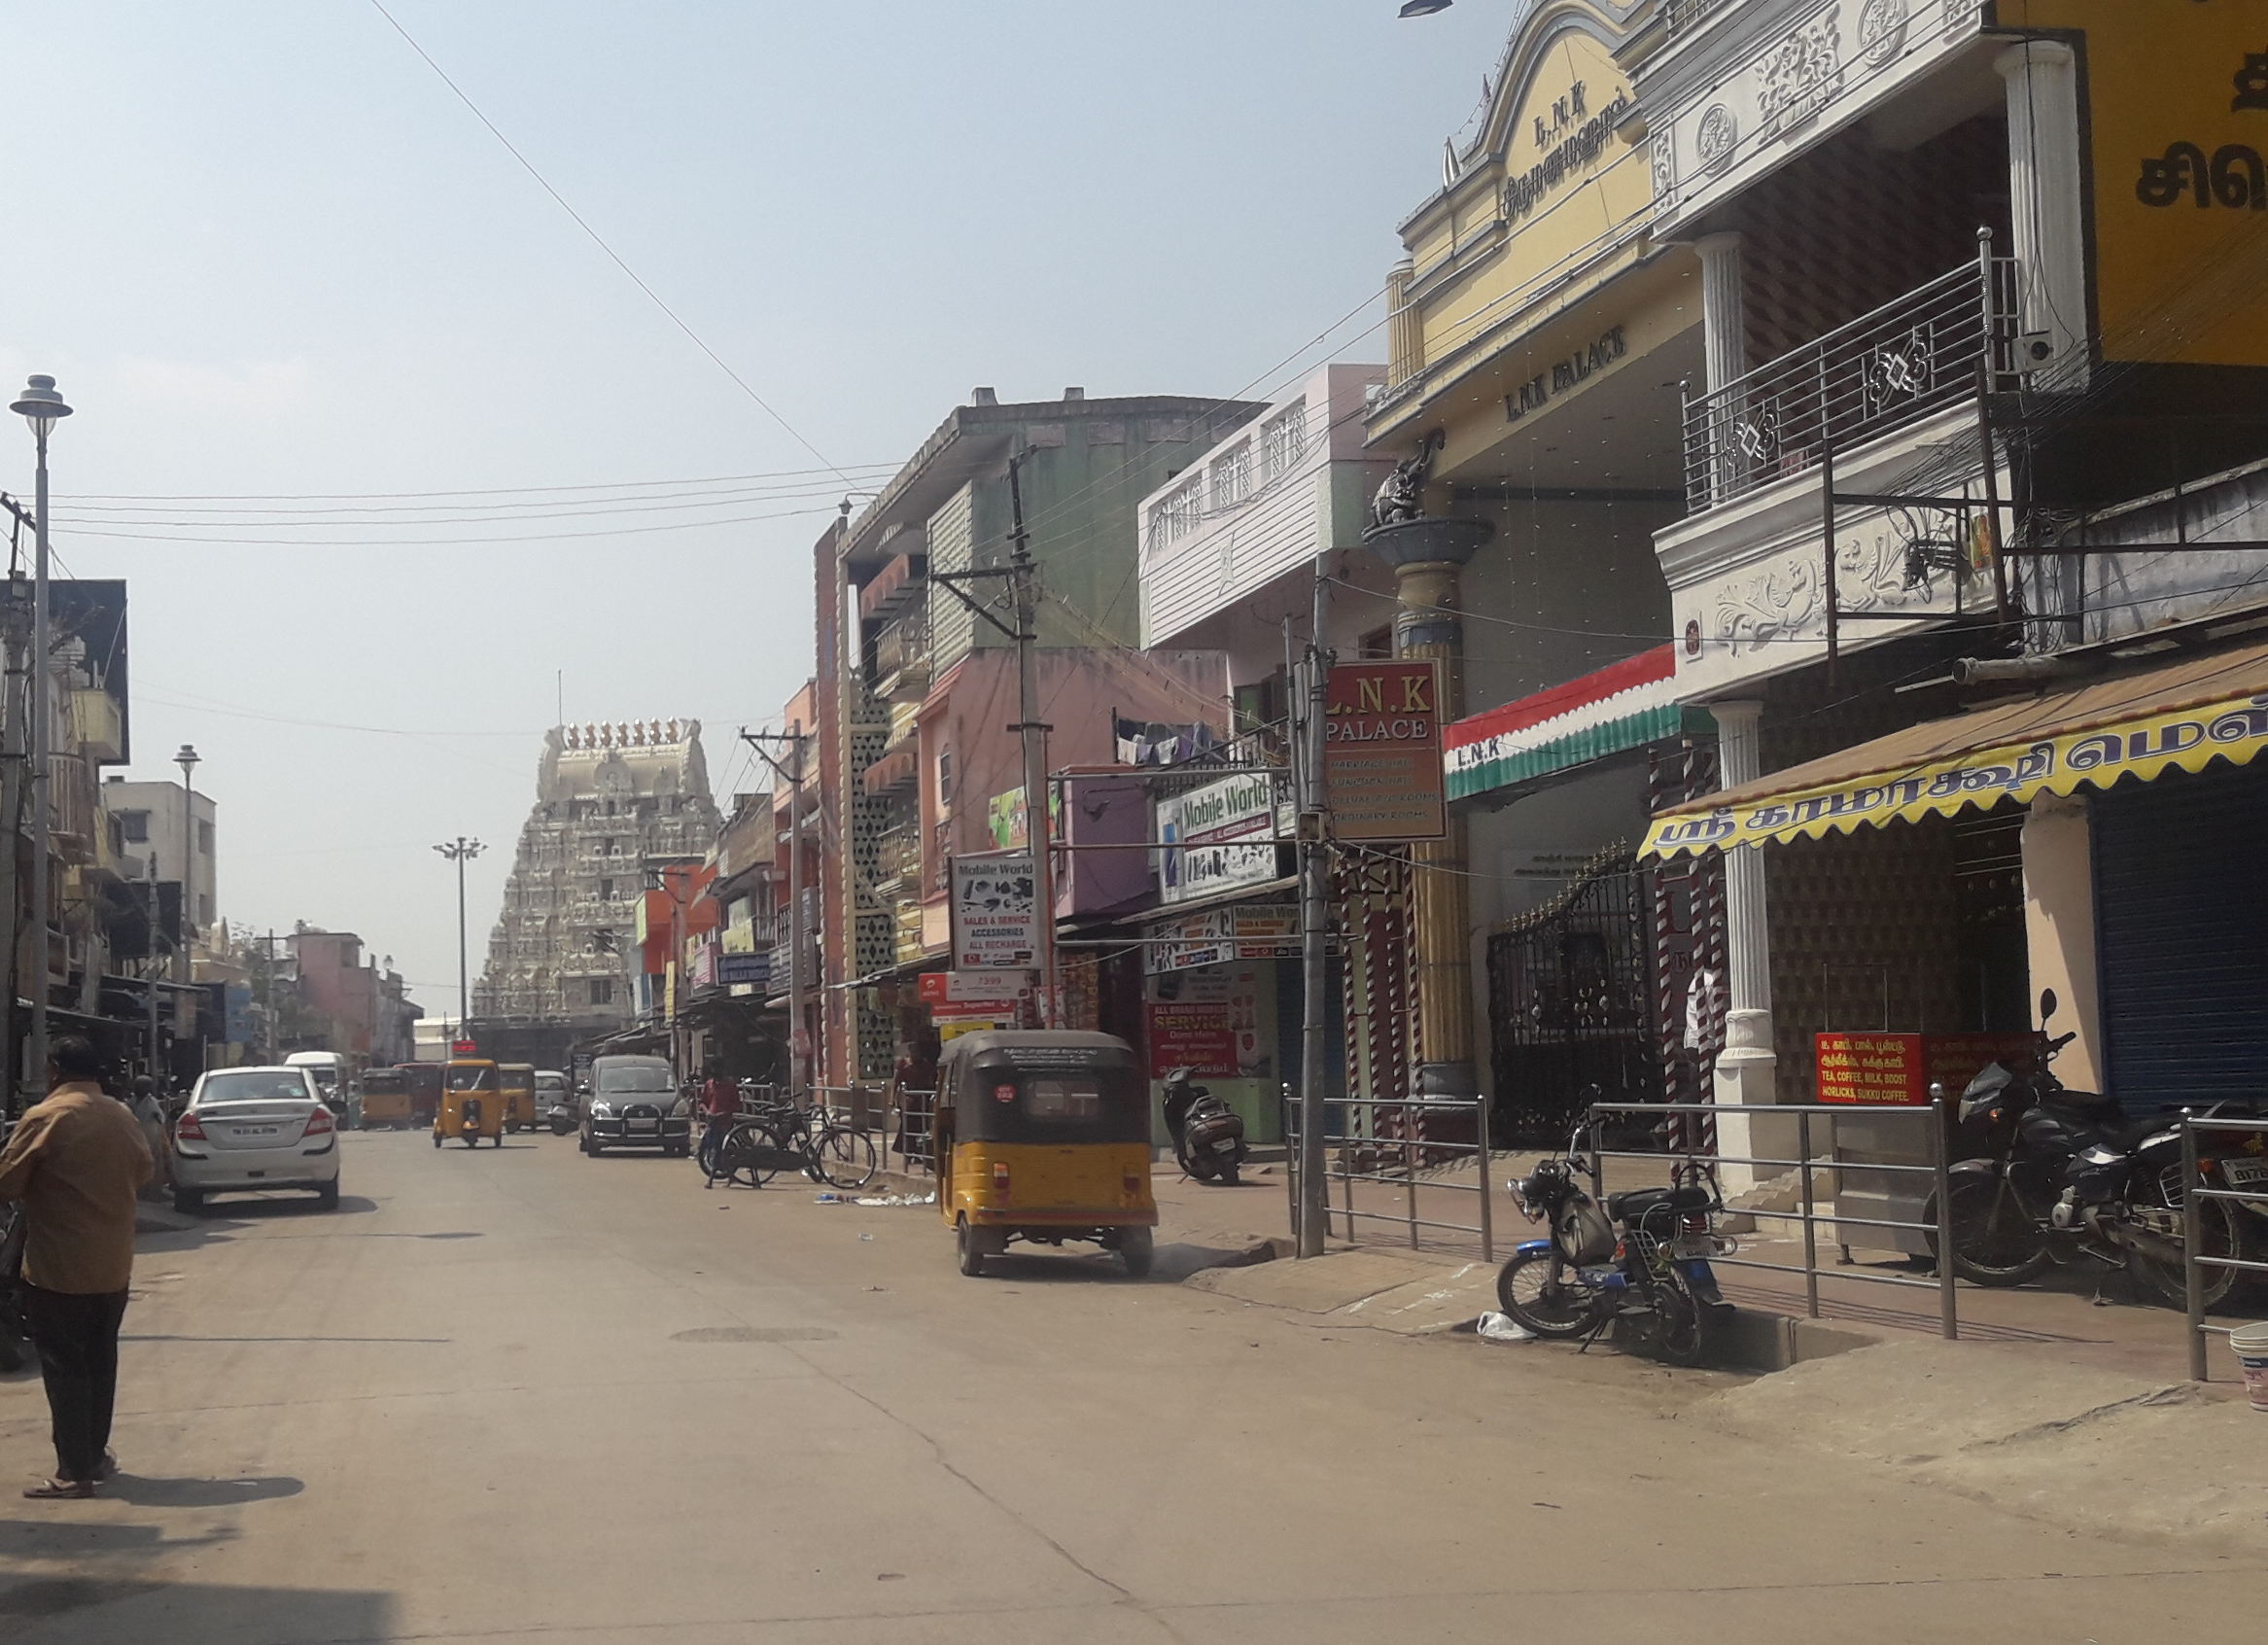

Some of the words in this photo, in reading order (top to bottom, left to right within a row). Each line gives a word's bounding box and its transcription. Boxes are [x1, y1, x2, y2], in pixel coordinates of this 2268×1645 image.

[1326, 718, 1429, 743] PALACE
[1457, 739, 1500, 766] L.N.K
[1183, 792, 1224, 829] Mobile
[1225, 775, 1268, 816] World
[1400, 792, 1437, 802] ROOMS
[1333, 812, 1386, 822] ORDINARY
[1390, 810, 1428, 820] ROOMS
[959, 864, 997, 875] Mobile
[999, 863, 1033, 874] World
[1236, 907, 1274, 919] Mobile
[1821, 1070, 1835, 1083] TEA,
[1836, 1071, 1864, 1084] COFFEE,
[1884, 1073, 1907, 1084] BOOST
[1822, 1086, 1856, 1101] HORLICKS,
[1857, 1088, 1880, 1100] SUKKU
